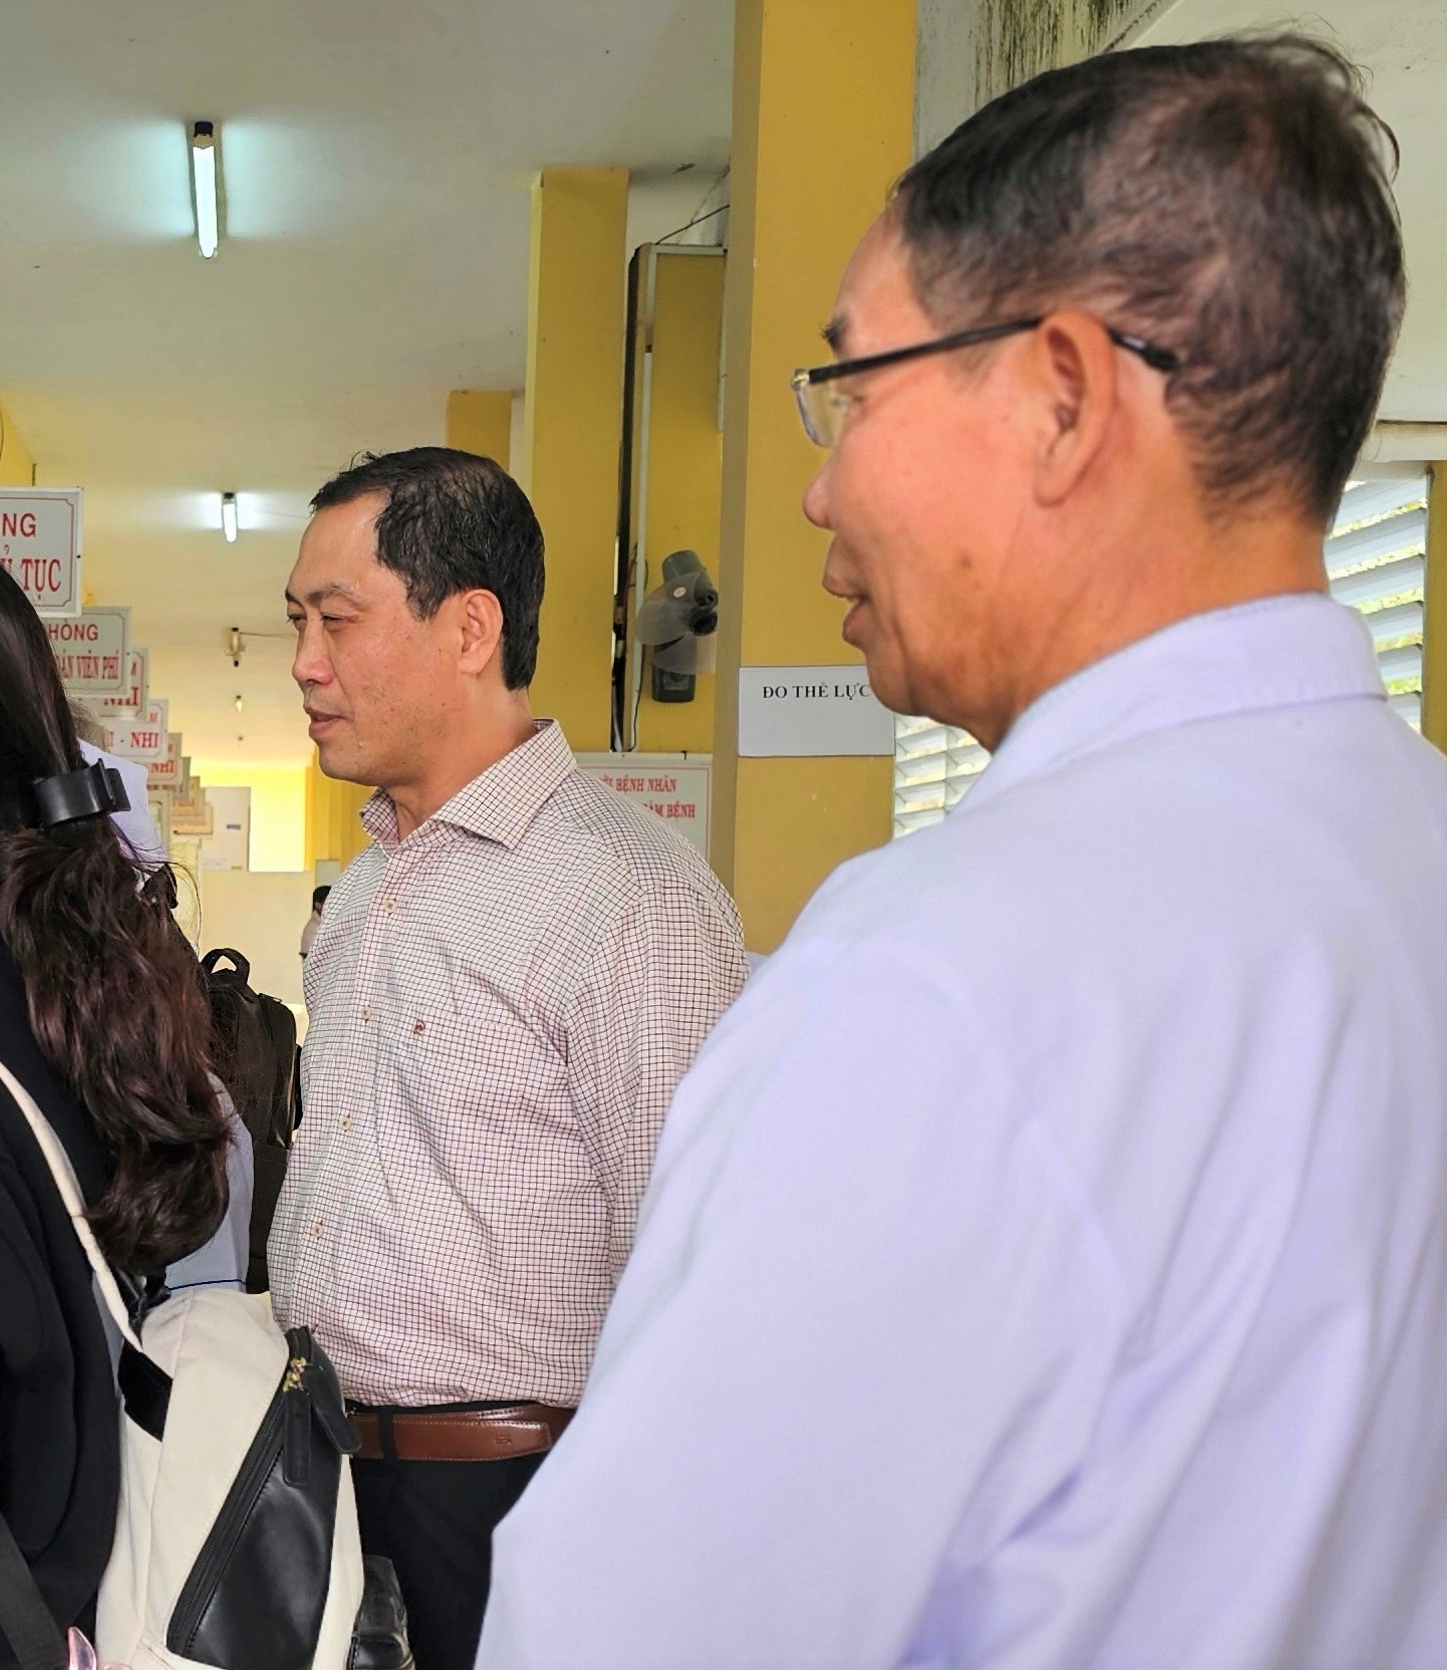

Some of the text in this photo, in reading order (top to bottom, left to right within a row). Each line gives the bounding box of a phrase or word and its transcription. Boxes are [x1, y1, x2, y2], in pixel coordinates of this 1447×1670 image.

[21, 558, 63, 600] TỤC
[47, 617, 99, 642] HÒNG
[762, 681, 871, 701] ĐO THỂ LỰC
[130, 731, 160, 748] NHI
[615, 774, 645, 795] BỆNH
[647, 774, 677, 793] NHÂN
[666, 799, 696, 822] BỆNH
